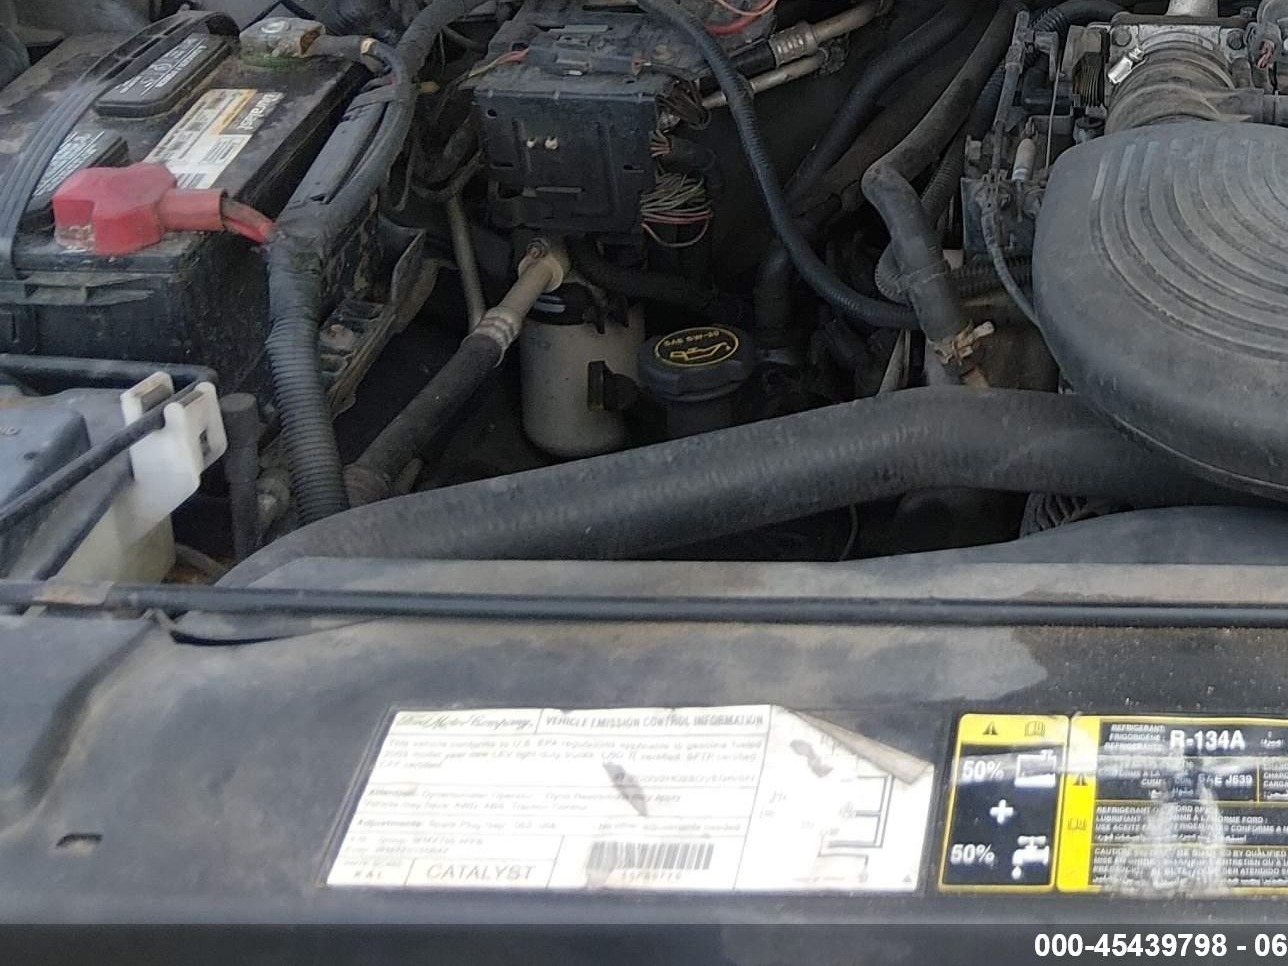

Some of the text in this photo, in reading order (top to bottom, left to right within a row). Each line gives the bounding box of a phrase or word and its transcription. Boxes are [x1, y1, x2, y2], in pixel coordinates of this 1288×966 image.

[546, 713, 763, 727] VEHICLE EMISSION CONTROL INFORMATION
[1169, 729, 1246, 751] R-134A
[961, 760, 1005, 783] 50%
[1225, 773, 1253, 785] J639
[950, 843, 996, 865] 50%
[426, 864, 536, 880] CATALYST
